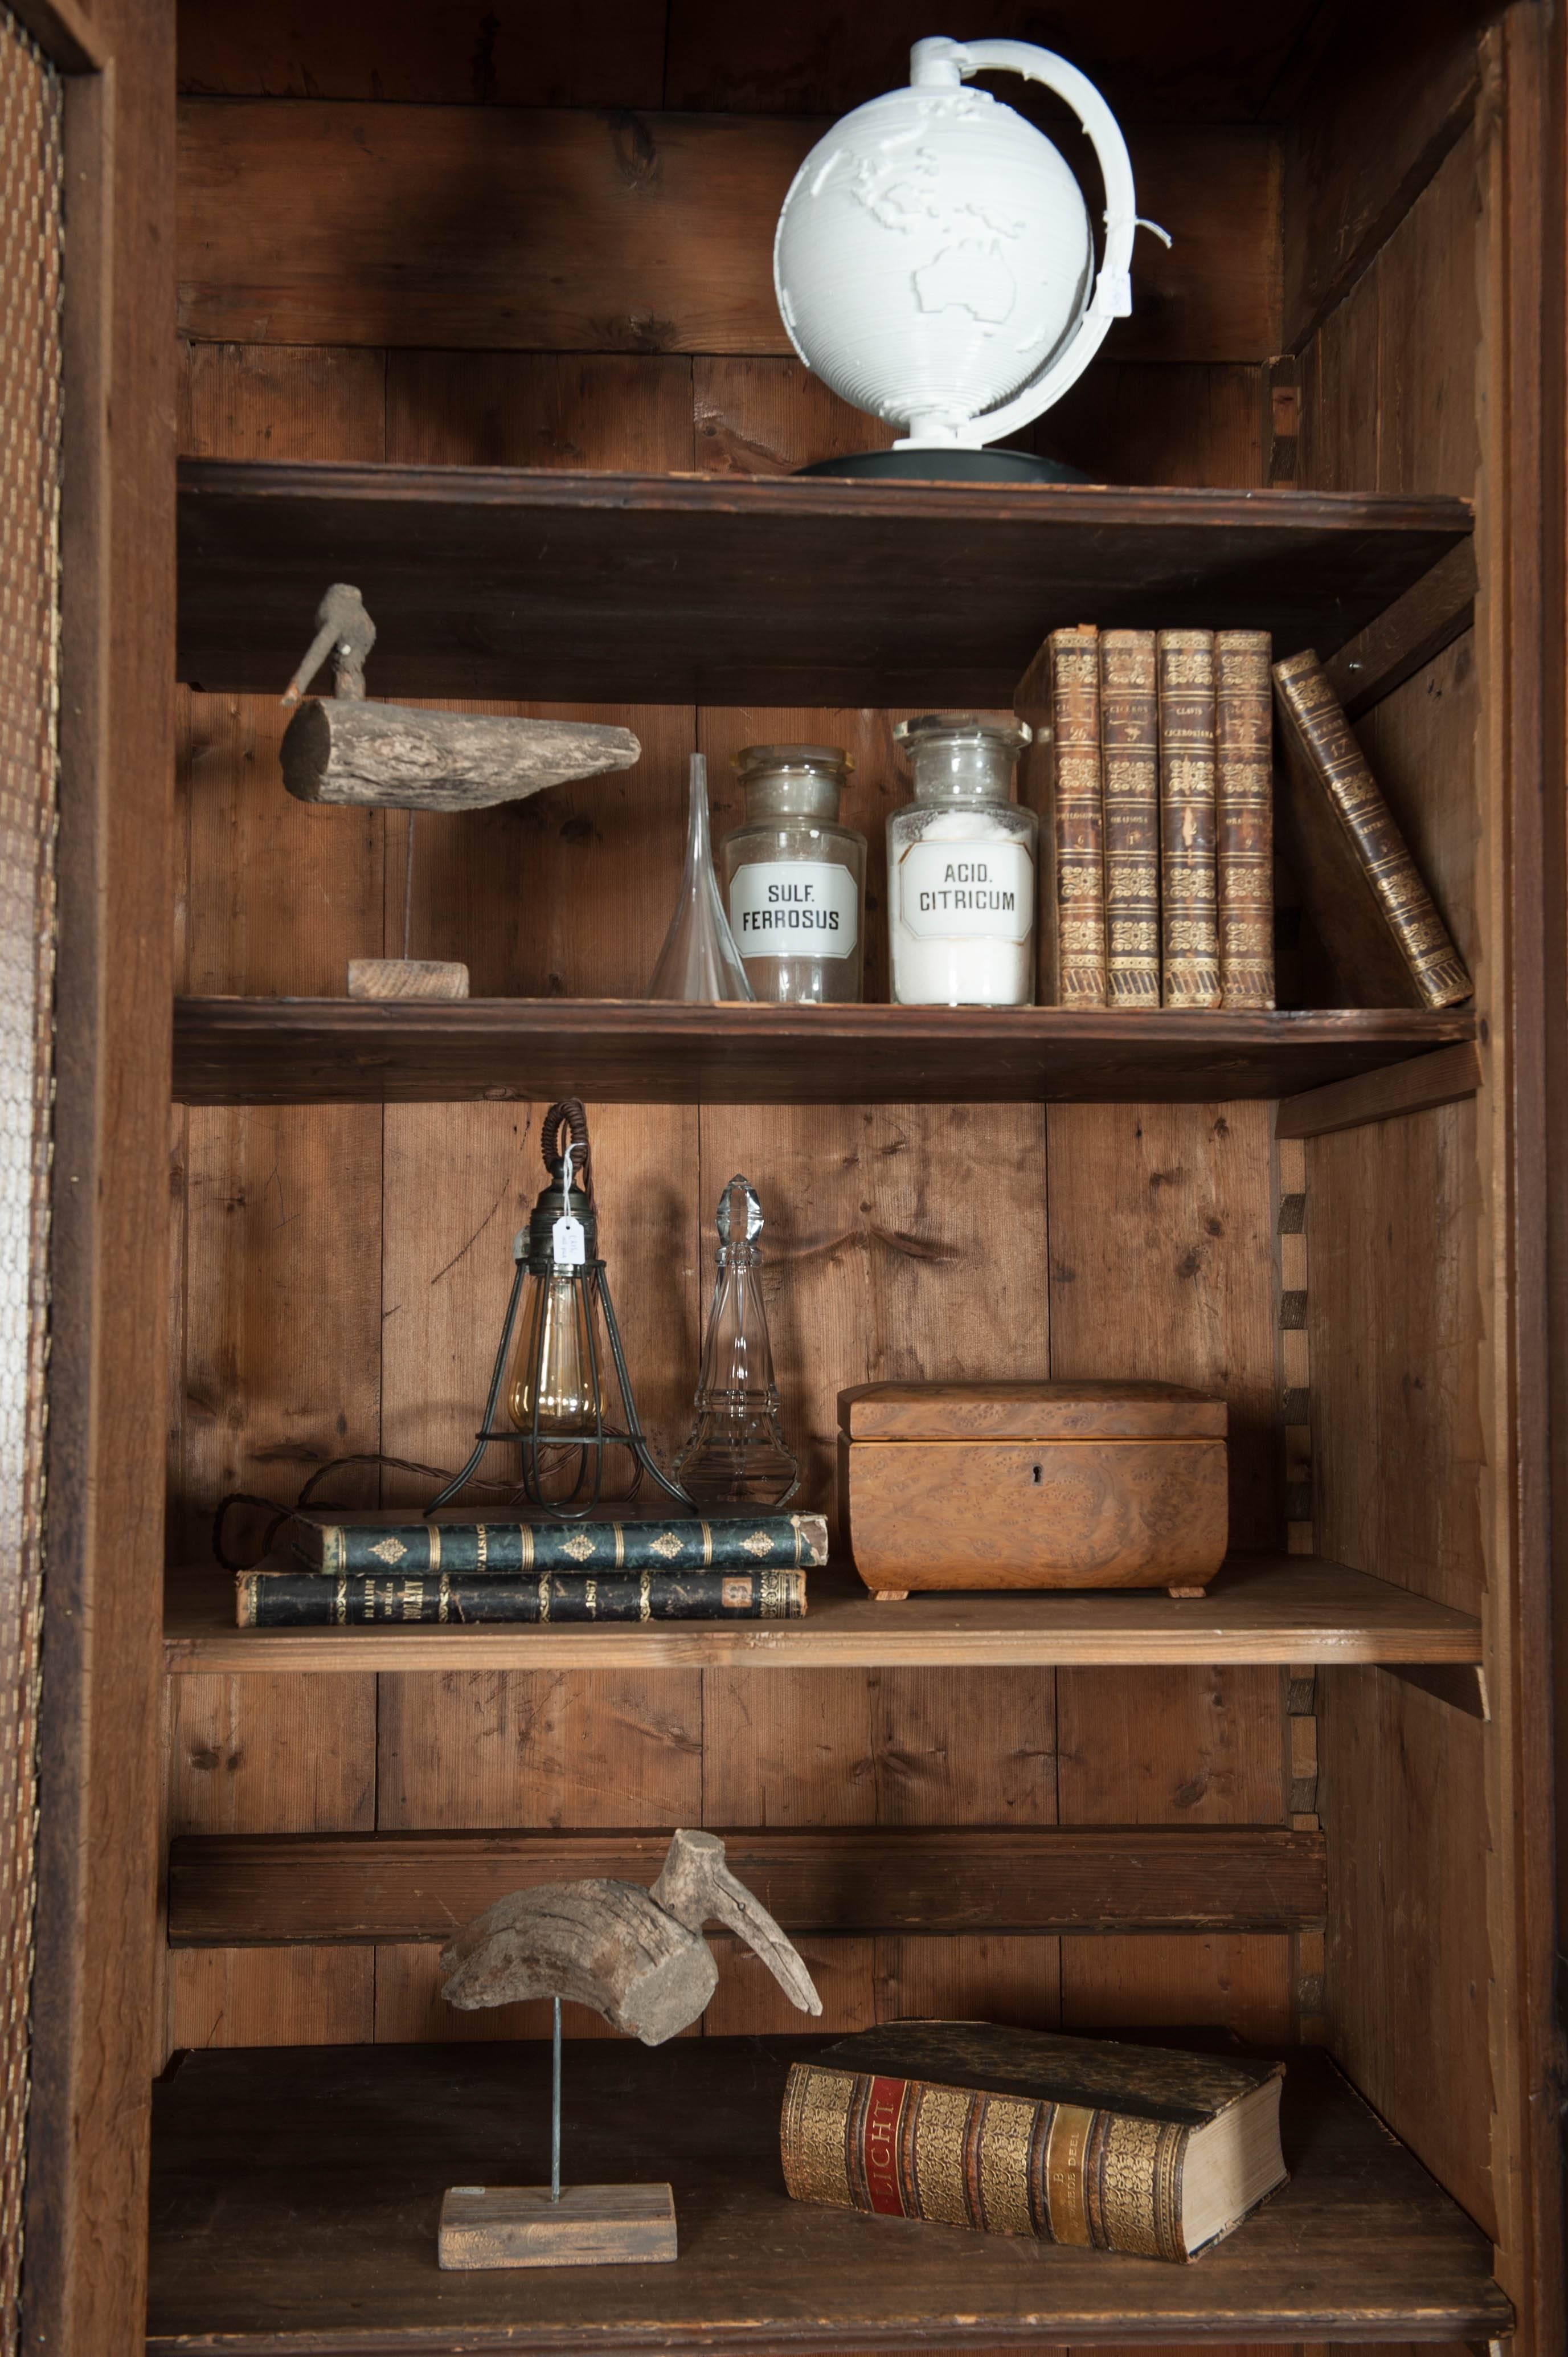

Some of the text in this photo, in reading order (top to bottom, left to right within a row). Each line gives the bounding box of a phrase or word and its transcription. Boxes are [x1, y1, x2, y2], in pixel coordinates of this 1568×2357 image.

[944, 864, 993, 883] ACID.
[768, 884, 814, 902] SULF.
[920, 890, 1015, 912] CITRICUM
[743, 910, 840, 932] FERROSUS
[586, 1580, 596, 1607] 1867
[871, 2099, 894, 2196] LICHT
[1068, 2133, 1080, 2167] DEEL
[1053, 2172, 1064, 2184] B
